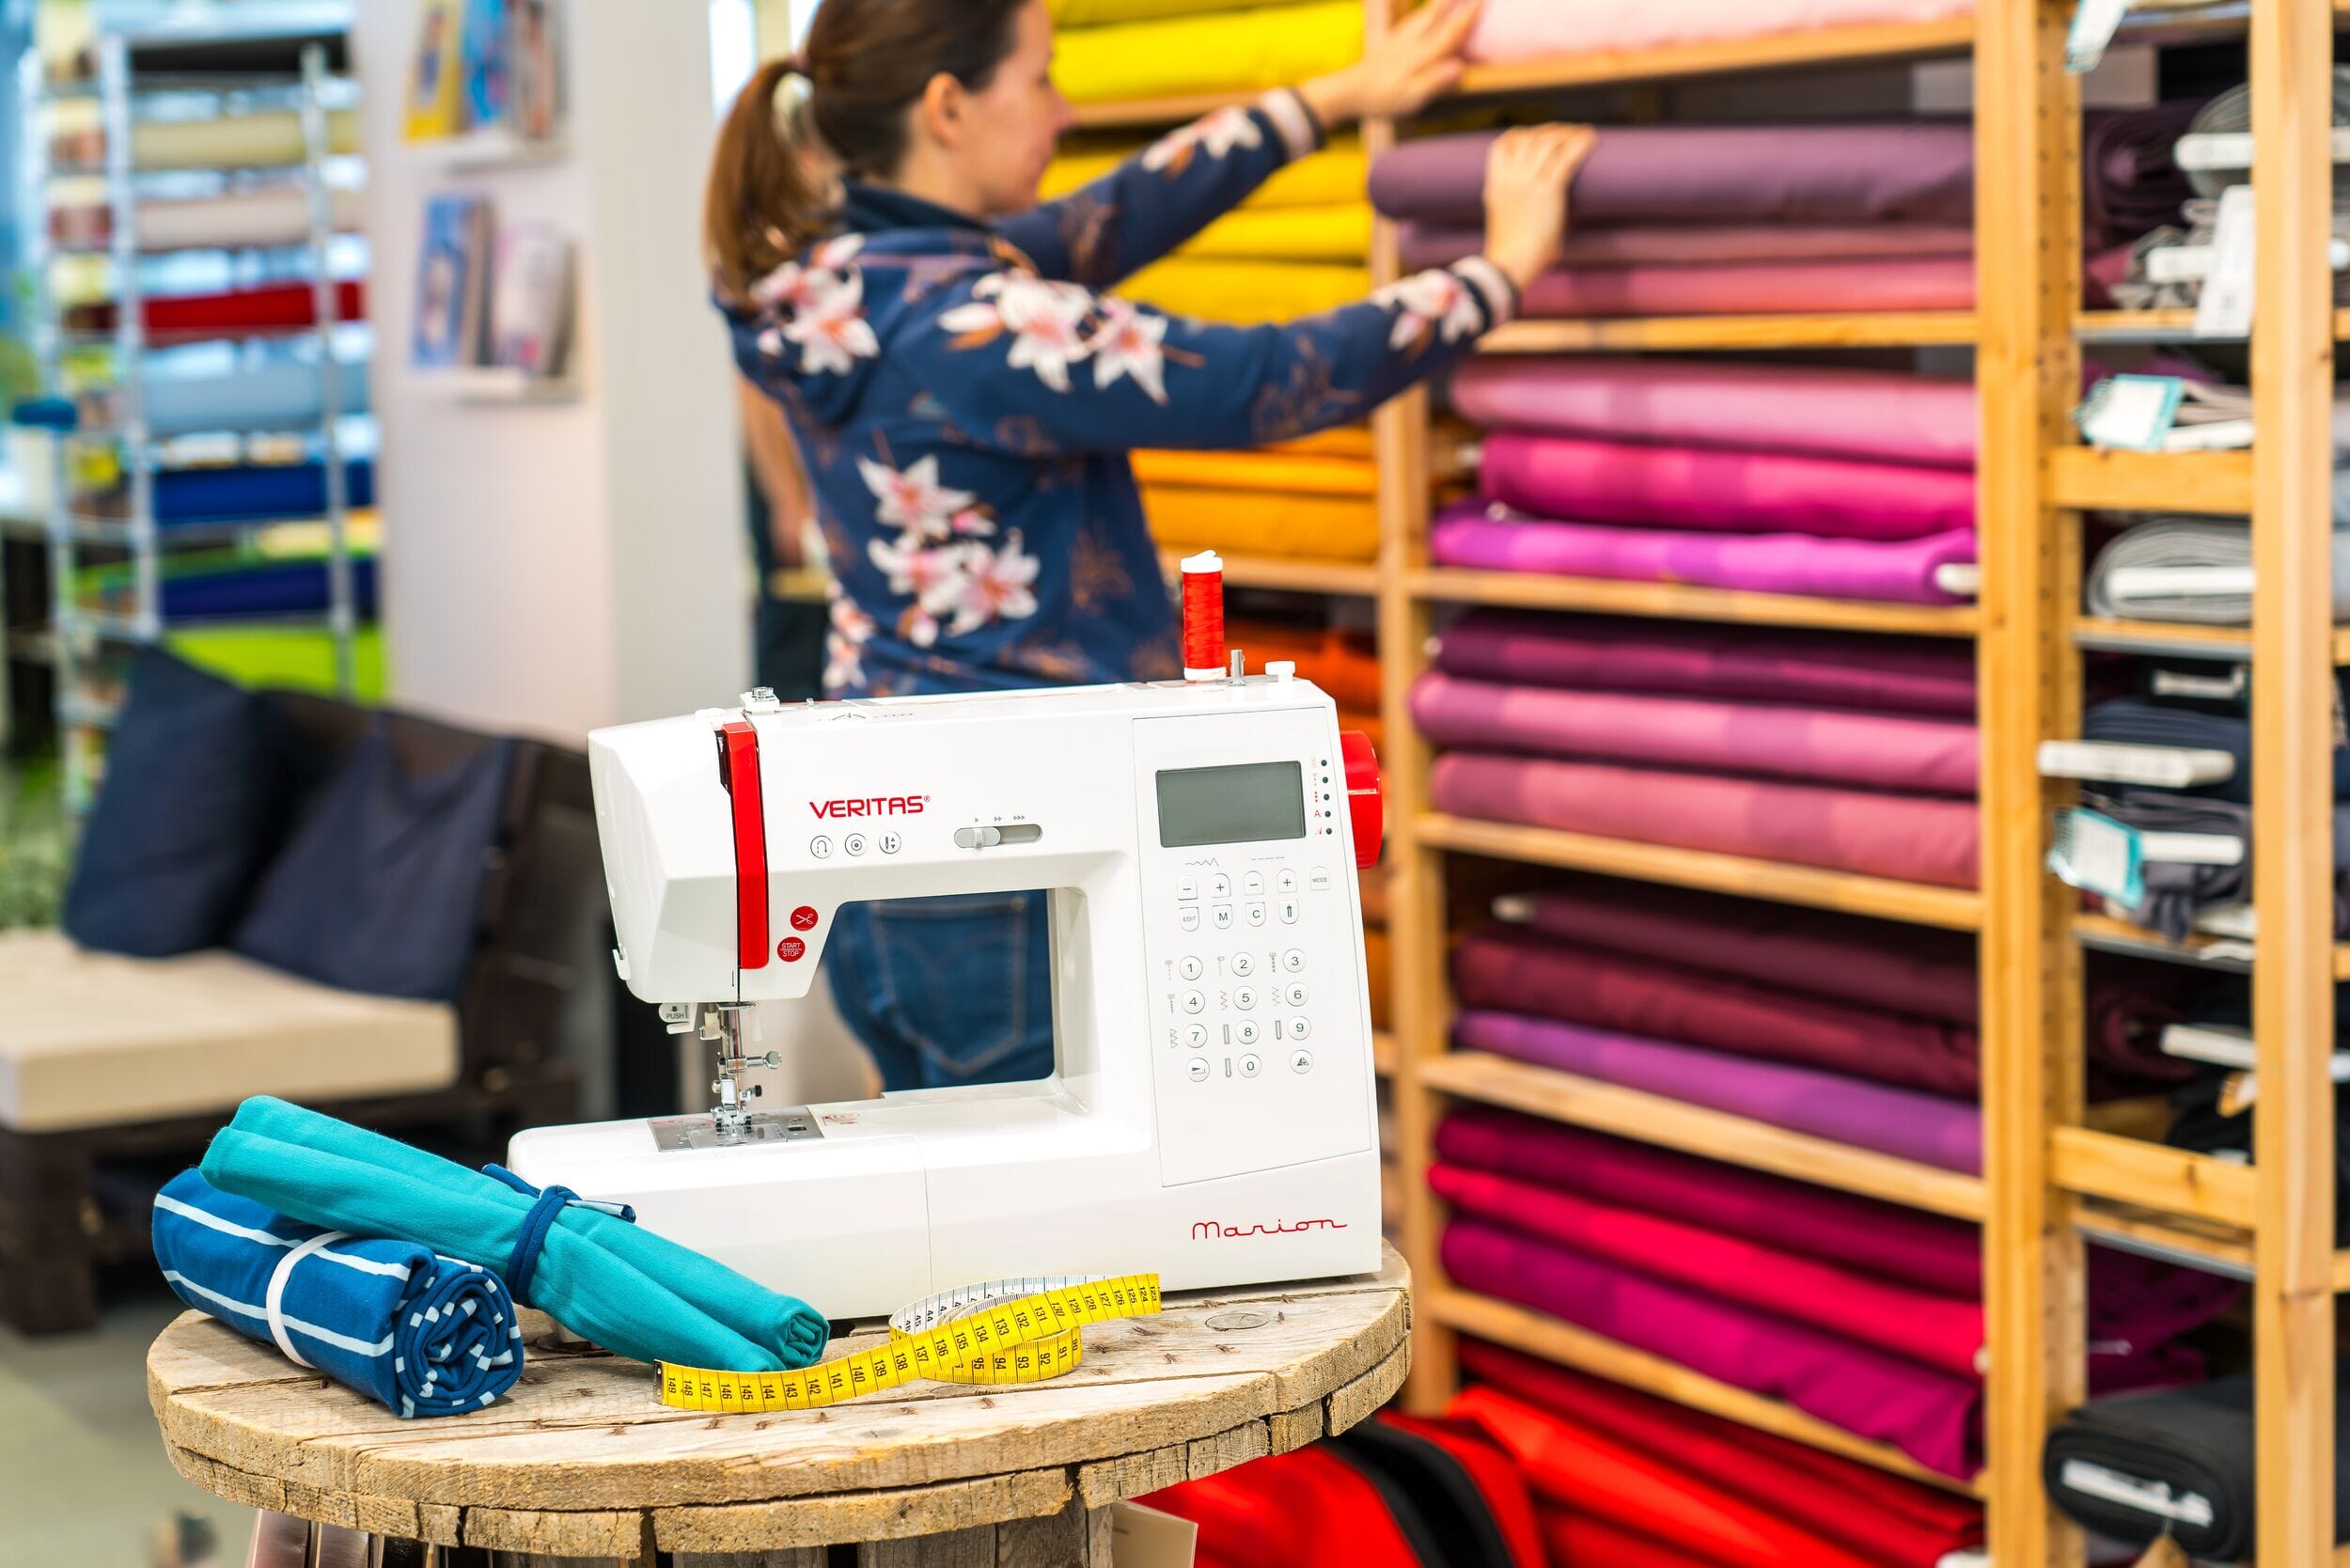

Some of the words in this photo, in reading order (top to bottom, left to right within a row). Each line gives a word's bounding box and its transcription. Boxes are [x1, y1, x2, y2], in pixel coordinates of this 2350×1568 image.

[1218, 912, 1229, 921] M
[1252, 909, 1261, 918] C
[1239, 960, 1248, 969] 2
[1292, 957, 1299, 966] 3
[1189, 997, 1198, 1006] 4
[1242, 994, 1250, 1003] 5
[1294, 990, 1302, 999] 6
[1244, 1027, 1253, 1037] 8
[1296, 1023, 1304, 1032] 9
[1192, 1032, 1199, 1042] 7
[1246, 1061, 1255, 1071] 0
[1192, 1219, 1348, 1240] Marion
[1100, 1292, 1112, 1308] 127
[1114, 1290, 1124, 1305] 126
[1128, 1288, 1136, 1303] 125
[1140, 1286, 1148, 1301] 124
[1051, 1302, 1065, 1317] 130
[1069, 1298, 1081, 1314] 129
[1085, 1295, 1097, 1310] 128
[916, 1315, 921, 1327] 45
[927, 1310, 933, 1322] 44
[1016, 1312, 1029, 1328] 132
[1035, 1306, 1048, 1321] 131
[975, 1325, 989, 1342] 134
[995, 1318, 1009, 1335] 133
[936, 1339, 948, 1356] 136
[955, 1332, 969, 1349] 135
[916, 1346, 929, 1362] 137
[1040, 1353, 1051, 1365] 92
[1059, 1346, 1067, 1358] 91
[874, 1359, 887, 1377] 139
[895, 1352, 908, 1370] 138
[973, 1357, 984, 1369] 95
[995, 1358, 1007, 1370] 94
[1018, 1356, 1029, 1369] 93
[830, 1372, 843, 1389] 141
[852, 1365, 865, 1383] 140
[667, 1377, 676, 1394] 149
[683, 1380, 693, 1396] 148
[702, 1382, 712, 1398] 147
[721, 1384, 732, 1399] 146
[742, 1385, 753, 1400] 145
[762, 1384, 775, 1399] 144
[785, 1383, 798, 1398] 143
[808, 1379, 821, 1394] 142
